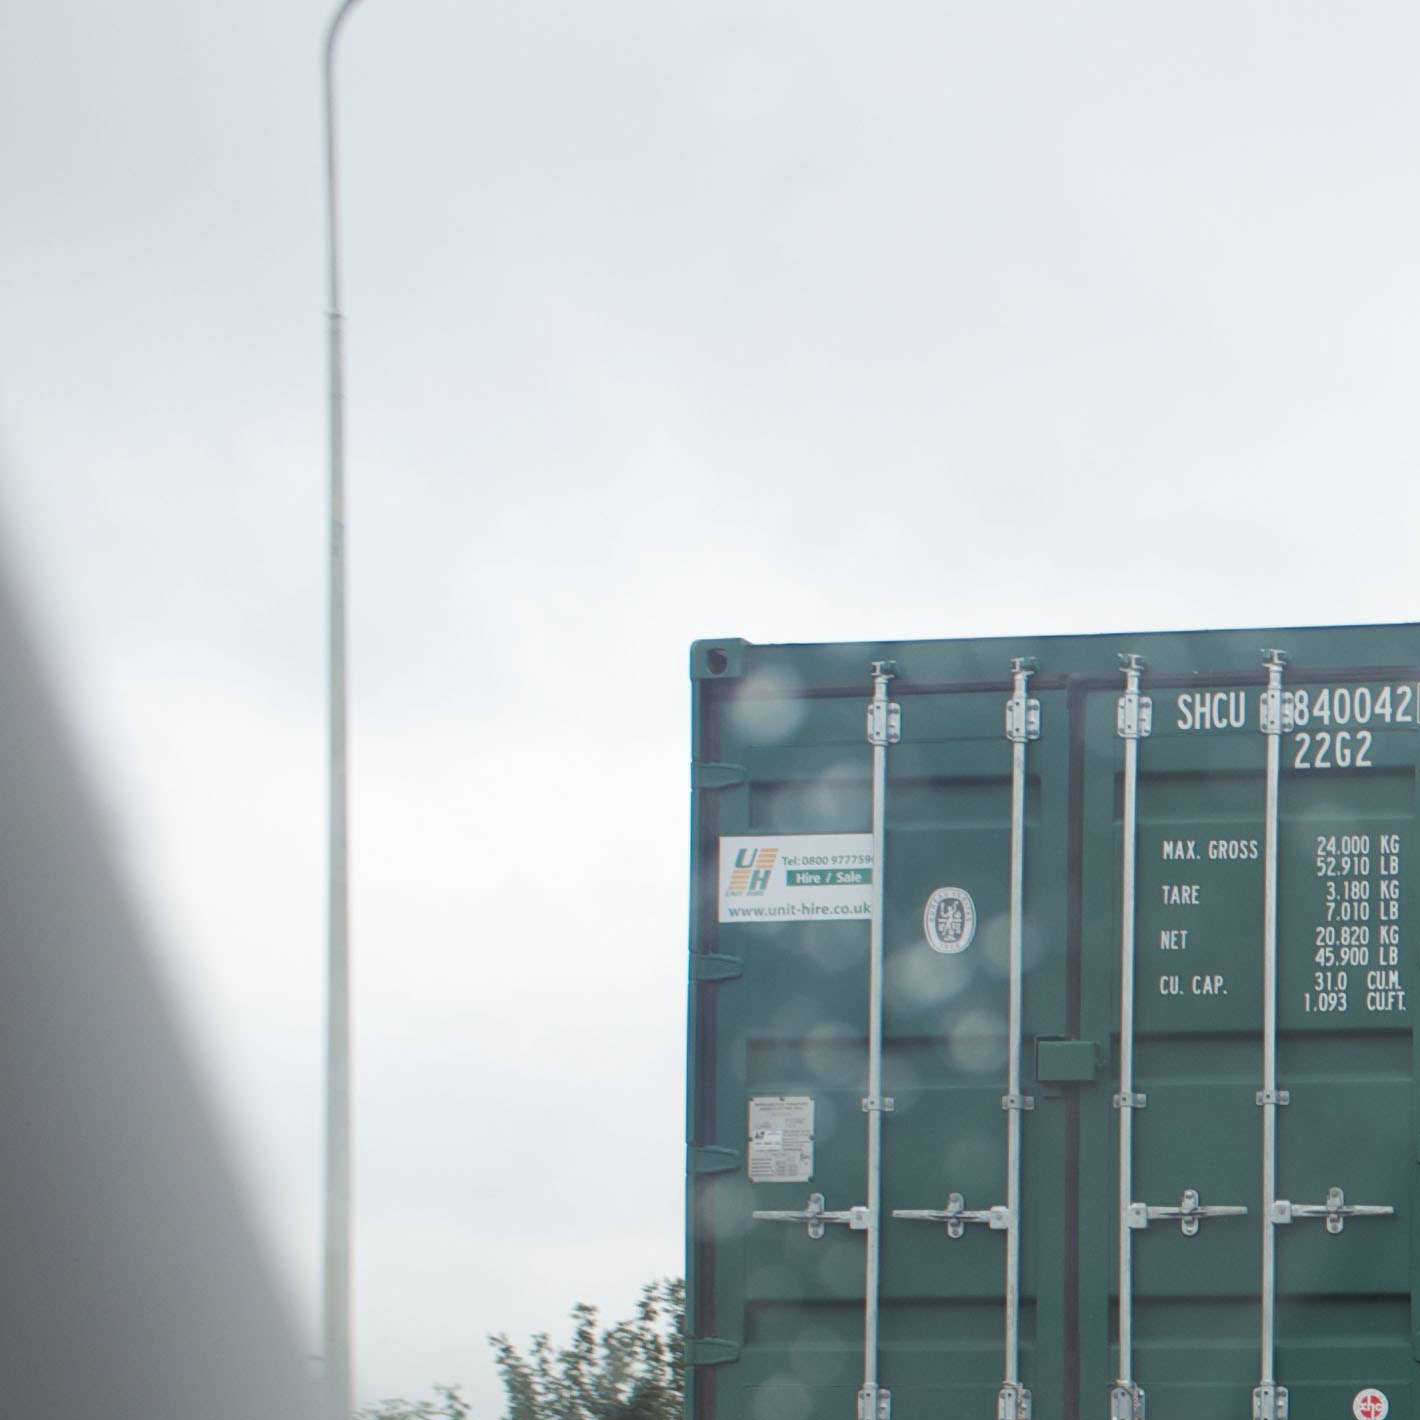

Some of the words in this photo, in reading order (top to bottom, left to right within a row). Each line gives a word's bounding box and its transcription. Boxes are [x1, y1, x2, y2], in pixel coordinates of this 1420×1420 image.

[1177, 691, 1245, 729] SHCU
[1294, 731, 1373, 769] 22G2
[1163, 840, 1200, 860] MAX.
[1208, 840, 1259, 859] GROSS
[1316, 835, 1370, 855] 24.000
[1380, 834, 1400, 854] KG
[782, 857, 800, 866] Tel:
[802, 855, 828, 865] 0800
[831, 854, 873, 865] 977759
[1316, 856, 1370, 876] 52.910
[1379, 855, 1399, 875] LB
[796, 871, 820, 884] Hire
[835, 871, 862, 884] Sale
[1162, 885, 1200, 905] TARE
[1326, 880, 1370, 900] 3.180
[1379, 880, 1400, 900] KG
[728, 902, 871, 917] www.unit-hire.co.uk
[1325, 901, 1370, 921] 7.010
[1379, 901, 1399, 921] LB
[1160, 930, 1188, 949] NET
[1315, 926, 1370, 946] 20.820
[1379, 925, 1400, 945] KG
[1315, 947, 1369, 967] 45.900
[1379, 947, 1398, 966] LB
[1159, 975, 1184, 995] CU.
[1192, 975, 1228, 995] CAP.
[1314, 971, 1347, 991] 31.0
[1304, 992, 1347, 1012] 1.093
